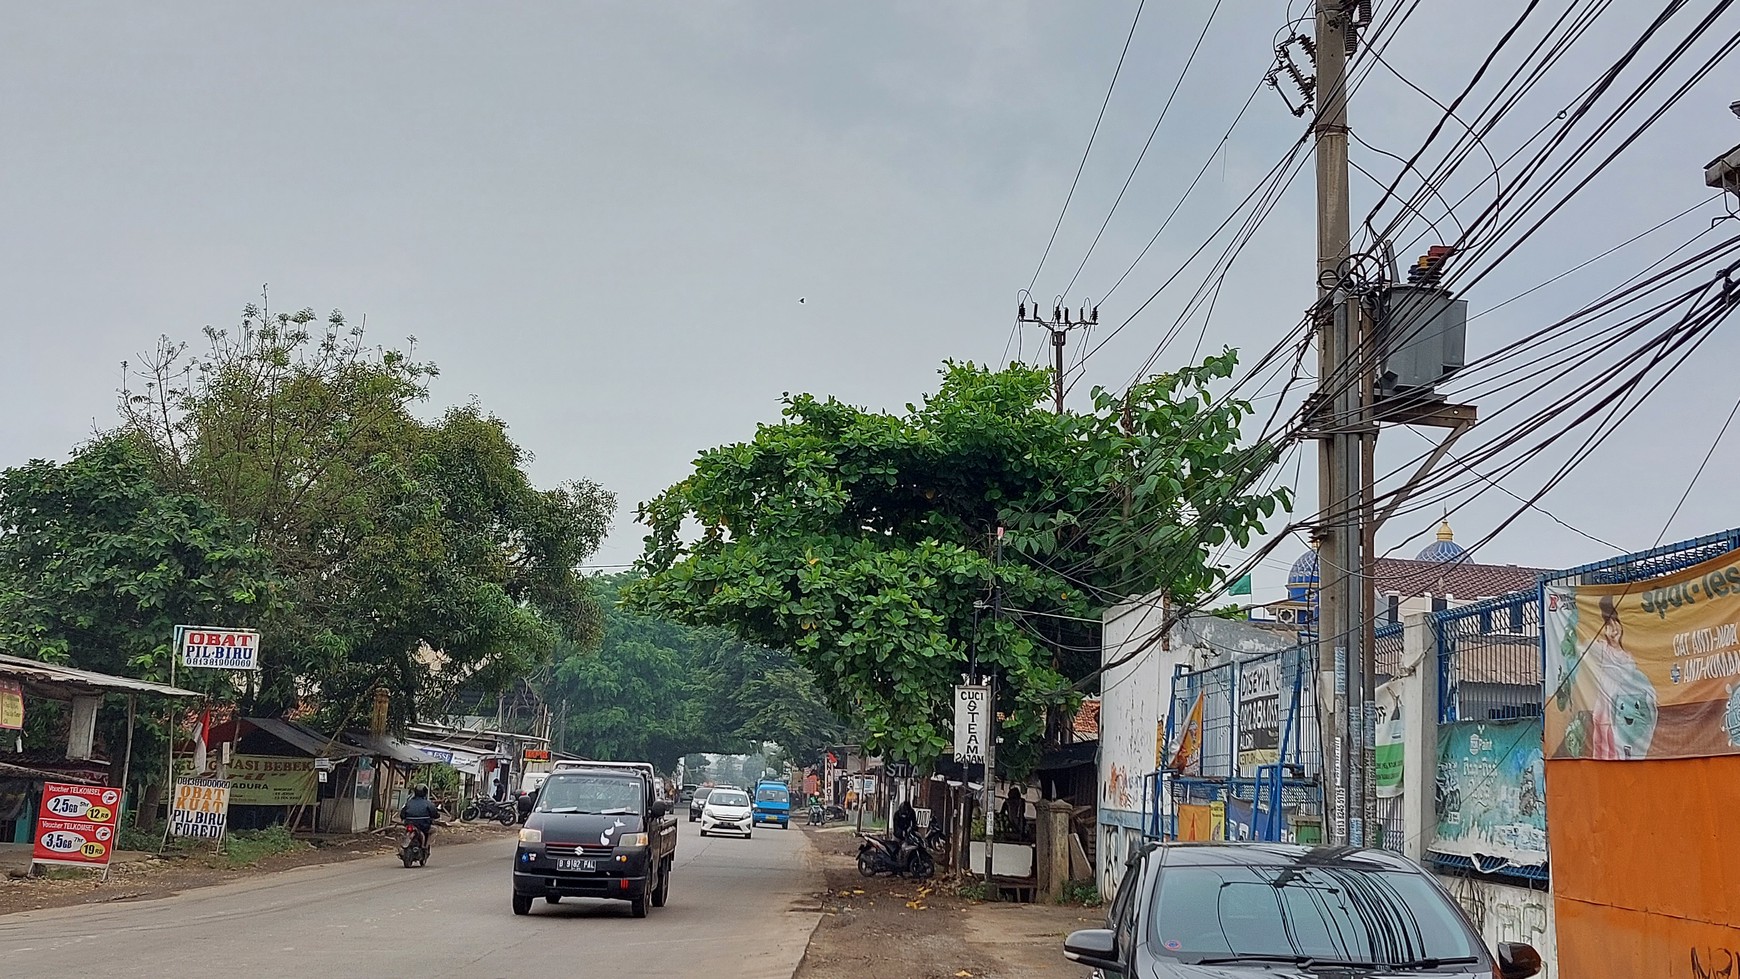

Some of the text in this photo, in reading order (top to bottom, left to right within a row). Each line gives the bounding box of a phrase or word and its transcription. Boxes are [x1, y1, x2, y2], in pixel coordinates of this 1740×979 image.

[189, 632, 252, 646] OBAT
[1673, 631, 1690, 657] CAT
[960, 691, 984, 701] CUCI
[966, 700, 980, 754] STEAM
[264, 761, 312, 772] BEBEK
[48, 785, 101, 796] Voucher TELKOMSEL
[181, 785, 225, 801] OBAT
[176, 797, 224, 813] KUAT
[89, 809, 100, 819] 12
[173, 809, 225, 826] PIL BIRU
[42, 821, 95, 832] Voucher TELKOMSEL
[174, 822, 223, 838] FOREDI
[84, 844, 94, 855] 19
